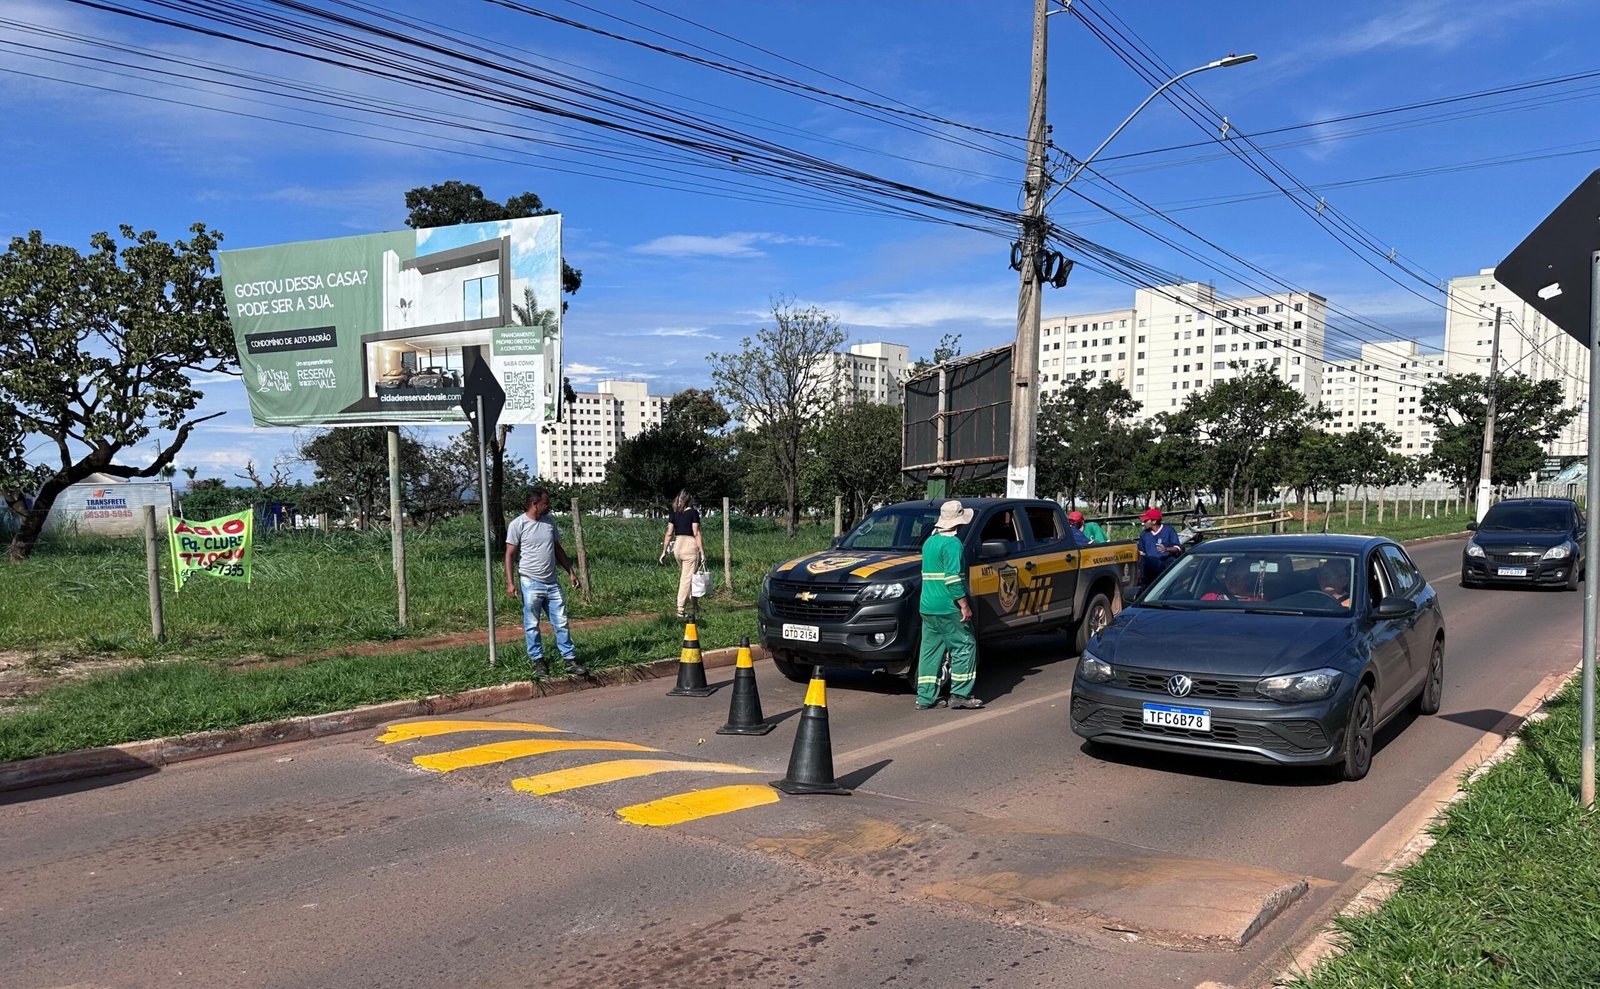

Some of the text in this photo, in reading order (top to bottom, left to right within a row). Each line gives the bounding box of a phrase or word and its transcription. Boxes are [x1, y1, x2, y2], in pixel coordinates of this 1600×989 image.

[235, 270, 368, 298] GOSTOU DESSA CASA?
[237, 294, 335, 317] PODE SER A SUA.
[250, 333, 332, 348] CONDOMÍNIO DE ALTO PADRÃO
[267, 369, 290, 381] Vista
[297, 367, 336, 380] RESERVA
[274, 379, 293, 392] Vale
[317, 379, 337, 389] VALE
[800, 631, 817, 639] 2154
[1150, 711, 1203, 728] TFC6B78
